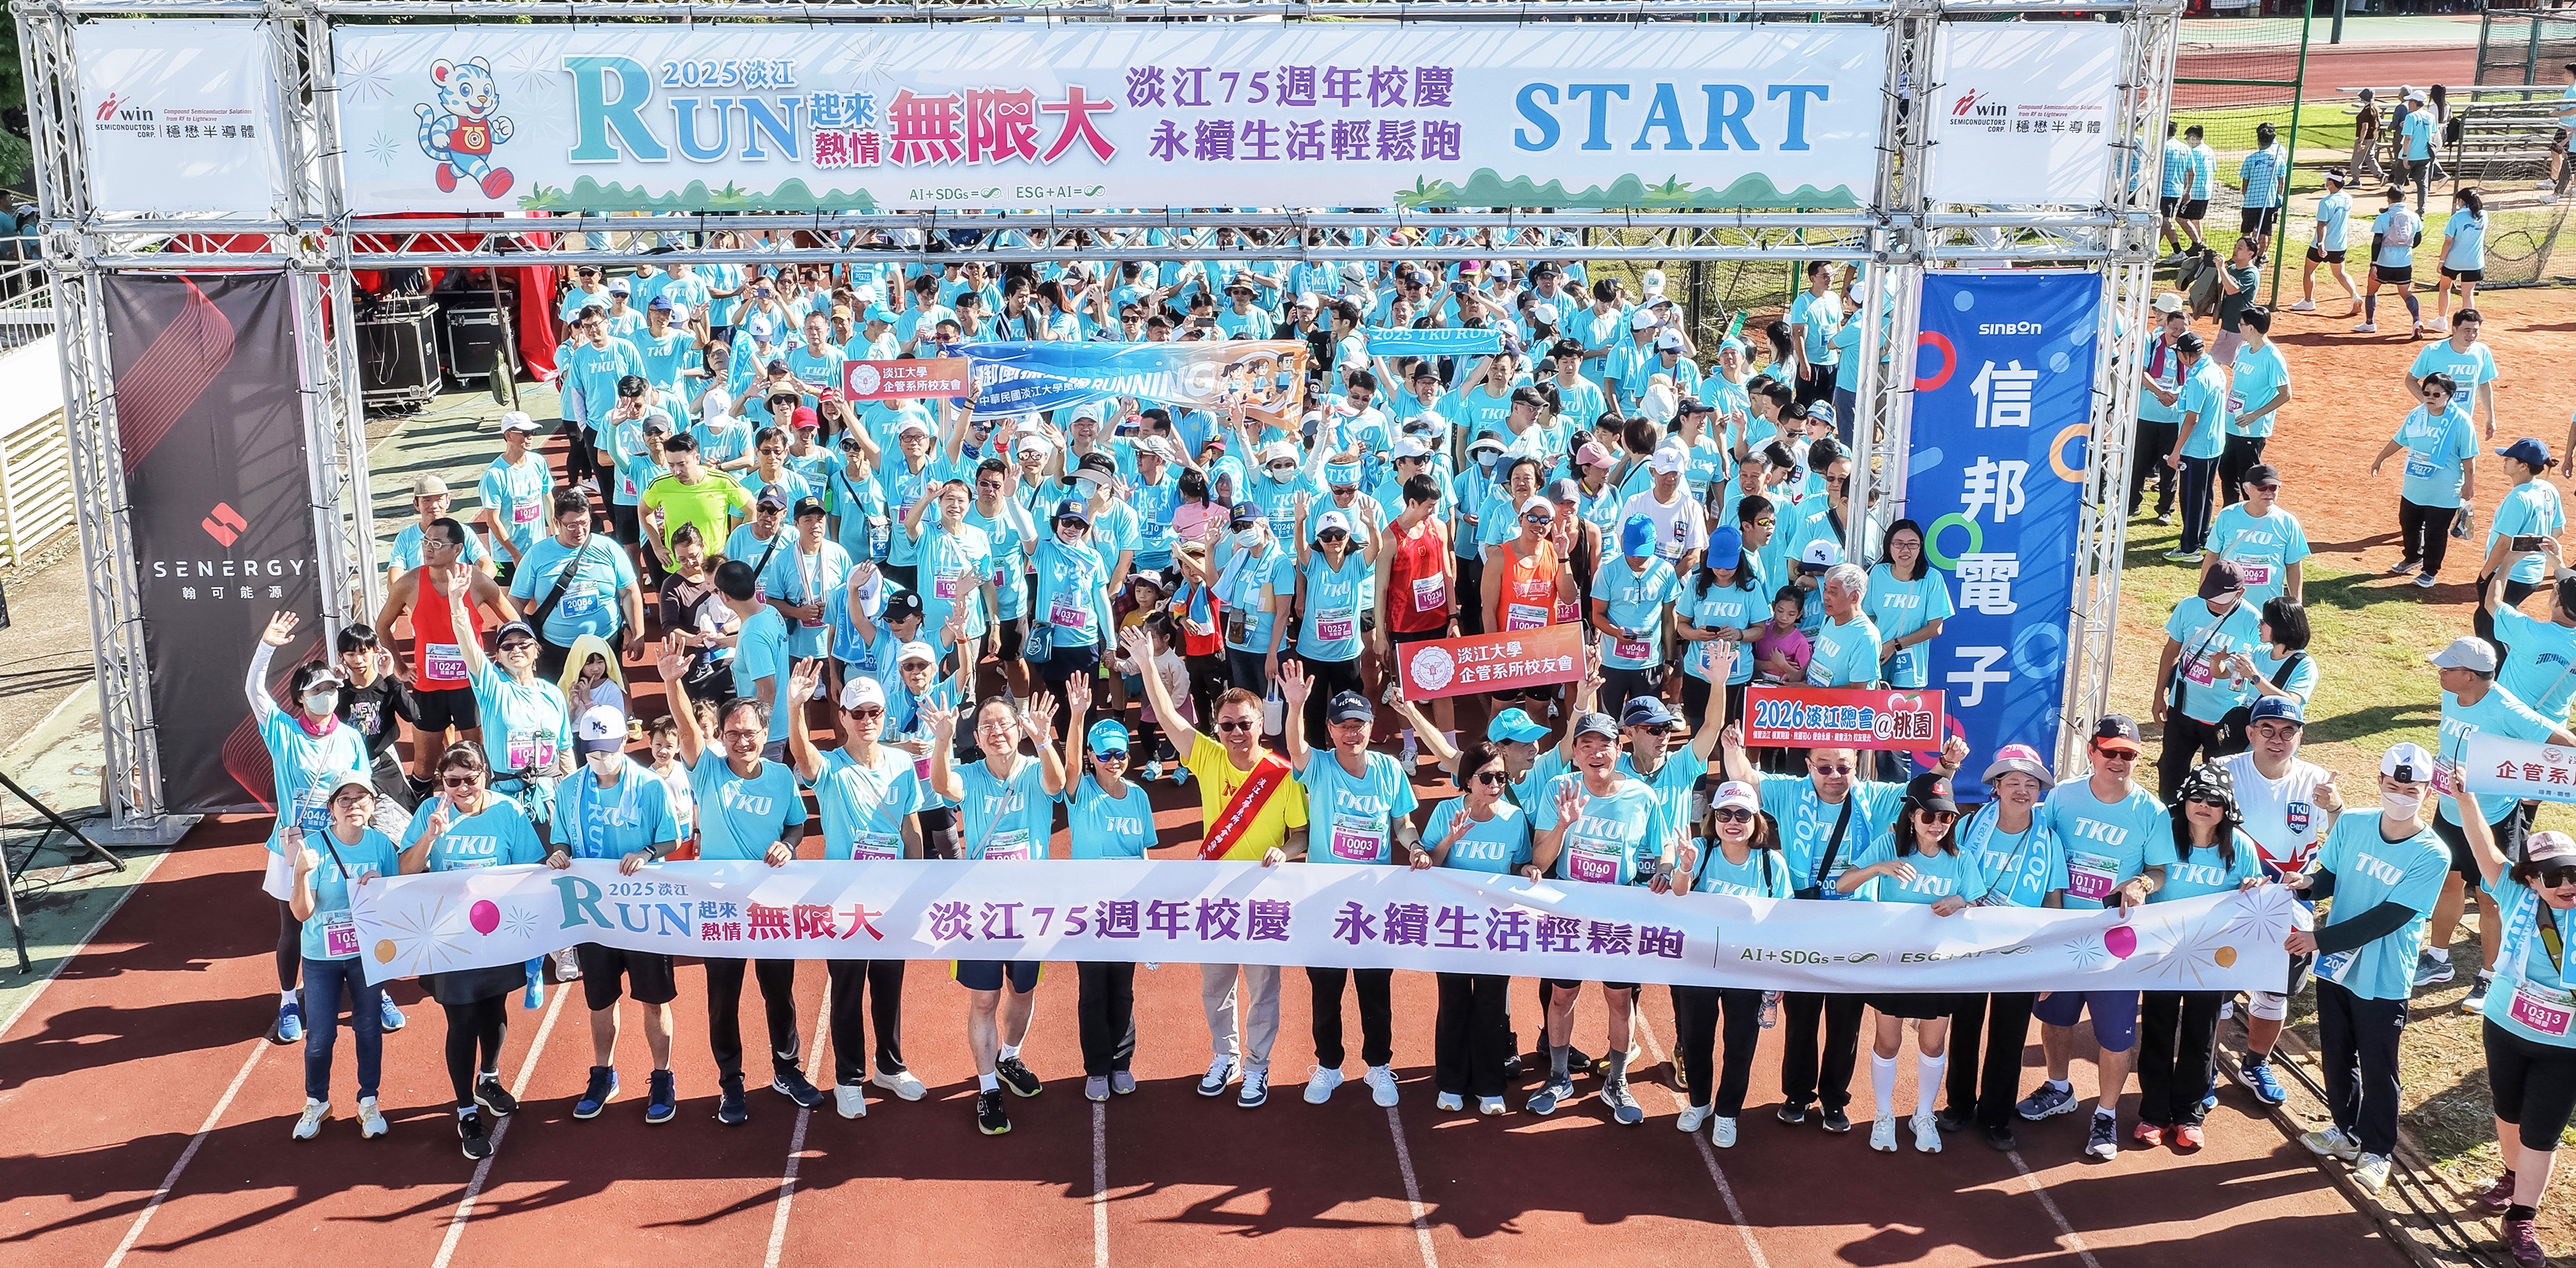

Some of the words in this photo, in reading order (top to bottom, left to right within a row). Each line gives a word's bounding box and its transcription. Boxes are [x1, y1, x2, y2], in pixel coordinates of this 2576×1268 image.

[1125, 65, 1454, 109] 淡江75週年校慶
[120, 106, 153, 121] win
[562, 54, 802, 163] RUN
[810, 92, 876, 128] 起來
[1976, 102, 2007, 116] win
[1514, 82, 1829, 152] START
[166, 125, 255, 138] 穩懋半導體
[889, 86, 1117, 166] 無限大
[2016, 120, 2101, 134] 穩懋半導體
[1149, 120, 1462, 162] 永續生活輕鬆跑
[814, 132, 881, 167] 熱情
[1419, 330, 1452, 340] TKU
[647, 346, 671, 357] TKU
[589, 360, 615, 374] TKU
[804, 366, 829, 377] TKU
[883, 367, 928, 379] 淡江大學
[2234, 361, 2254, 375] TKU
[2447, 364, 2477, 375] TKU
[883, 379, 961, 393] 企管系所校友會
[1089, 363, 1215, 398] RUNNING
[1481, 407, 1510, 420] TKU
[1561, 400, 1580, 412] KU
[1327, 467, 1360, 483] TKU
[520, 507, 537, 518] 10141
[1946, 359, 2038, 708] 信邦電子
[2236, 529, 2273, 545] TKU
[154, 559, 304, 578] SENERGY
[2245, 569, 2264, 578] 0062
[182, 585, 282, 600] 翰可能源
[942, 583, 956, 591] 100
[1324, 581, 1351, 597] TKU
[1622, 586, 1659, 601] TKU
[567, 597, 592, 609] 20086
[1423, 590, 1442, 602] 10236
[1883, 593, 1920, 609] TKU
[1061, 610, 1081, 620] 0371
[1557, 606, 1573, 615] 0121
[1704, 601, 1742, 617] TKU
[1323, 623, 1348, 633] 10257
[1457, 641, 1523, 664] 淡江大學
[1817, 635, 1841, 658] TKU
[434, 662, 462, 671] 10247
[1459, 655, 1573, 683] 企管系所校友會
[518, 747, 547, 760] 1044
[2436, 772, 2449, 784] 100
[2496, 761, 2576, 785] 企管系
[984, 792, 1024, 815] TKU
[1337, 788, 1379, 814] TKU
[602, 807, 625, 827] KU
[2289, 804, 2308, 815] TKU
[1105, 815, 1142, 835] TKU
[1575, 815, 1624, 840] TKU
[1793, 787, 1818, 858] 2025
[2075, 817, 2128, 846] TKU
[446, 834, 497, 854] TKU
[1342, 837, 1372, 851] 10003
[1455, 840, 1505, 861] TKU
[1577, 859, 1610, 874] 10060
[2171, 862, 2225, 886] TKU
[2357, 852, 2403, 886] TKU
[1706, 878, 1756, 897] TKU
[1900, 875, 1951, 896] TKU
[2071, 874, 2103, 891] 10111
[552, 875, 691, 936] RUN
[697, 901, 737, 919] 起來
[746, 902, 884, 942] 無限大
[930, 898, 1293, 942] 淡江75週年校慶
[1333, 903, 1685, 959] 永續生活輕鬆跑
[336, 930, 357, 944] 103
[701, 922, 741, 942] 熱情
[2323, 956, 2344, 970] 200
[2522, 1002, 2561, 1024] 10313
